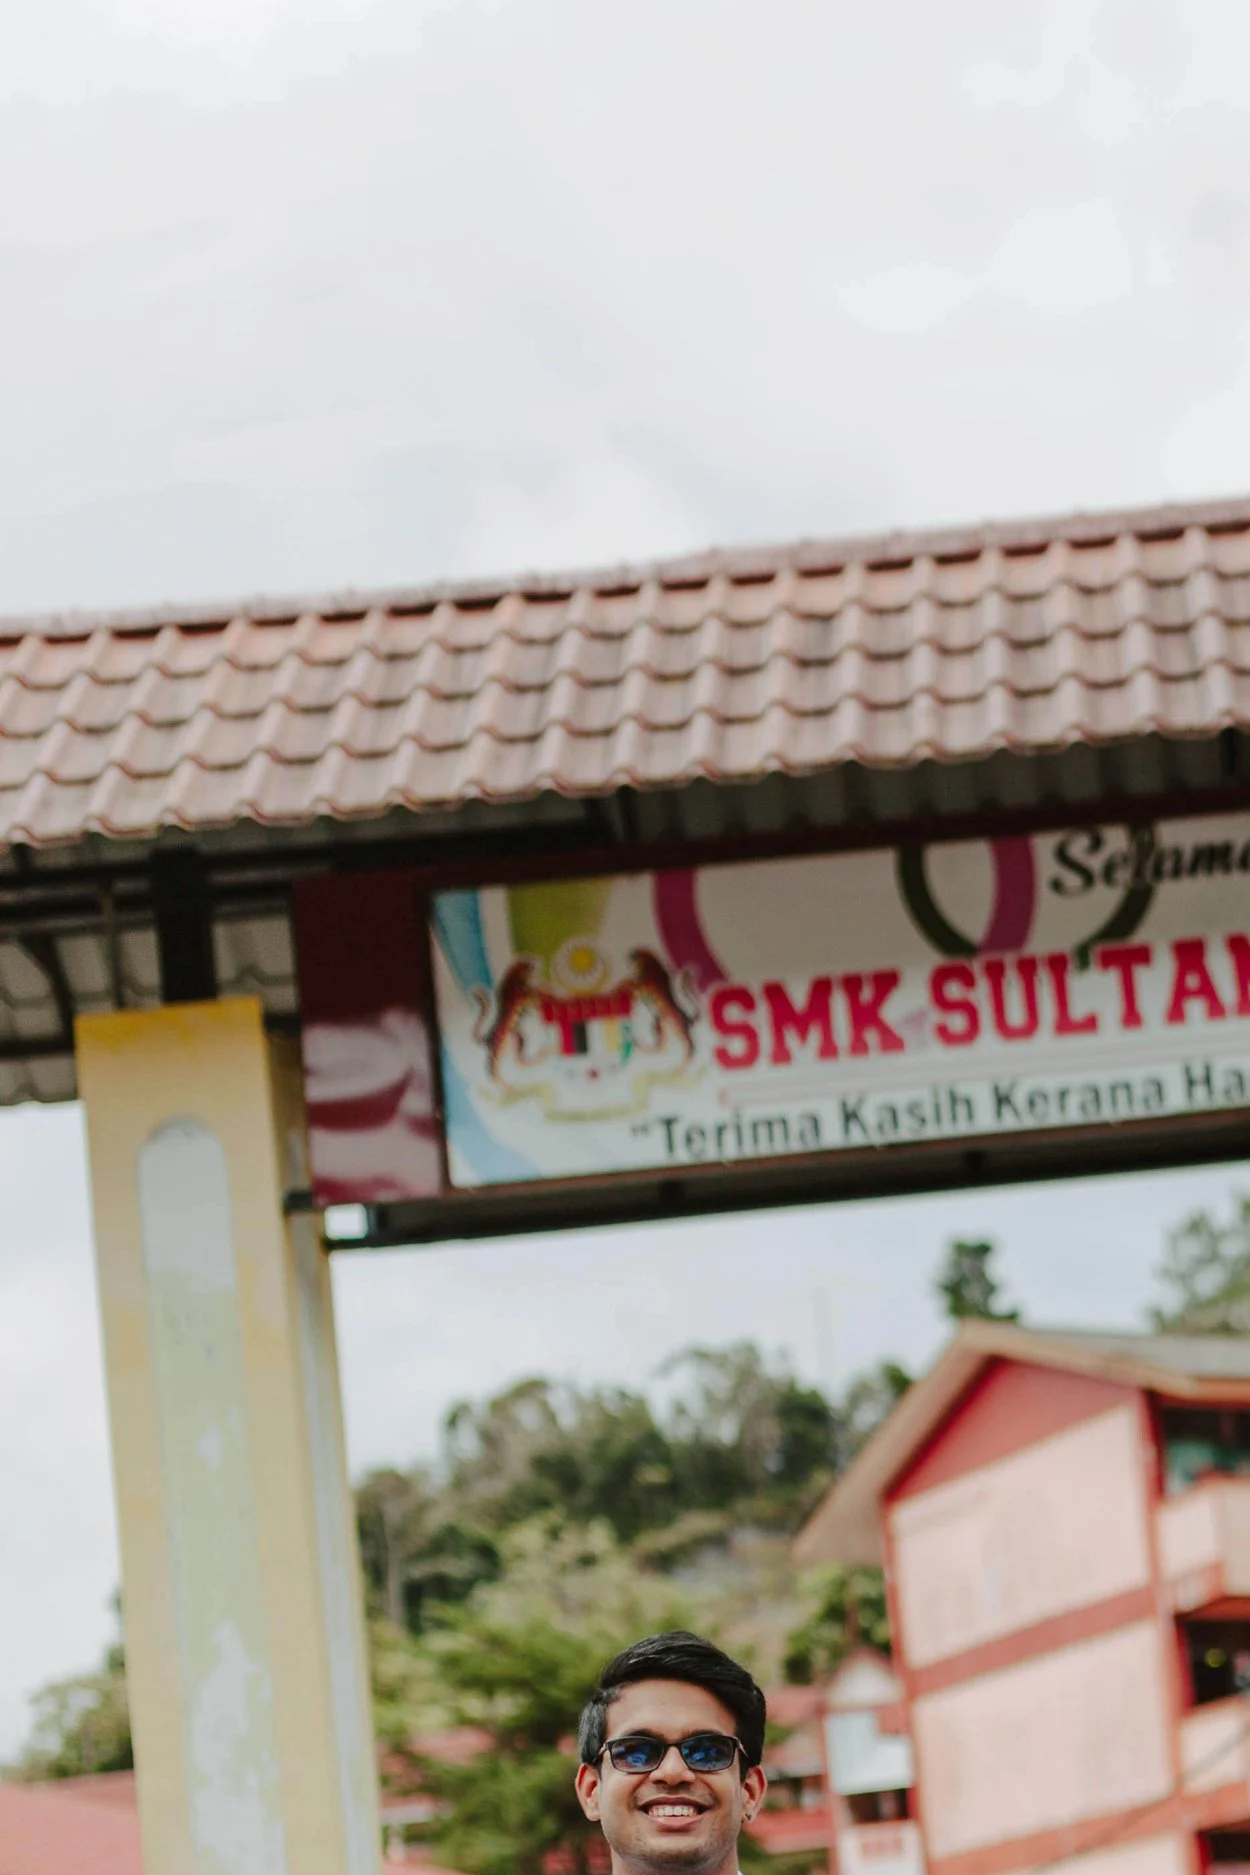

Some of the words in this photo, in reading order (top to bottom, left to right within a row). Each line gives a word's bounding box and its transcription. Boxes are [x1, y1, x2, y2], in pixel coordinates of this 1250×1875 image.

[708, 970, 905, 1069] SMK
[838, 1085, 974, 1143] Kasih
[992, 1076, 1165, 1126] Kerana
